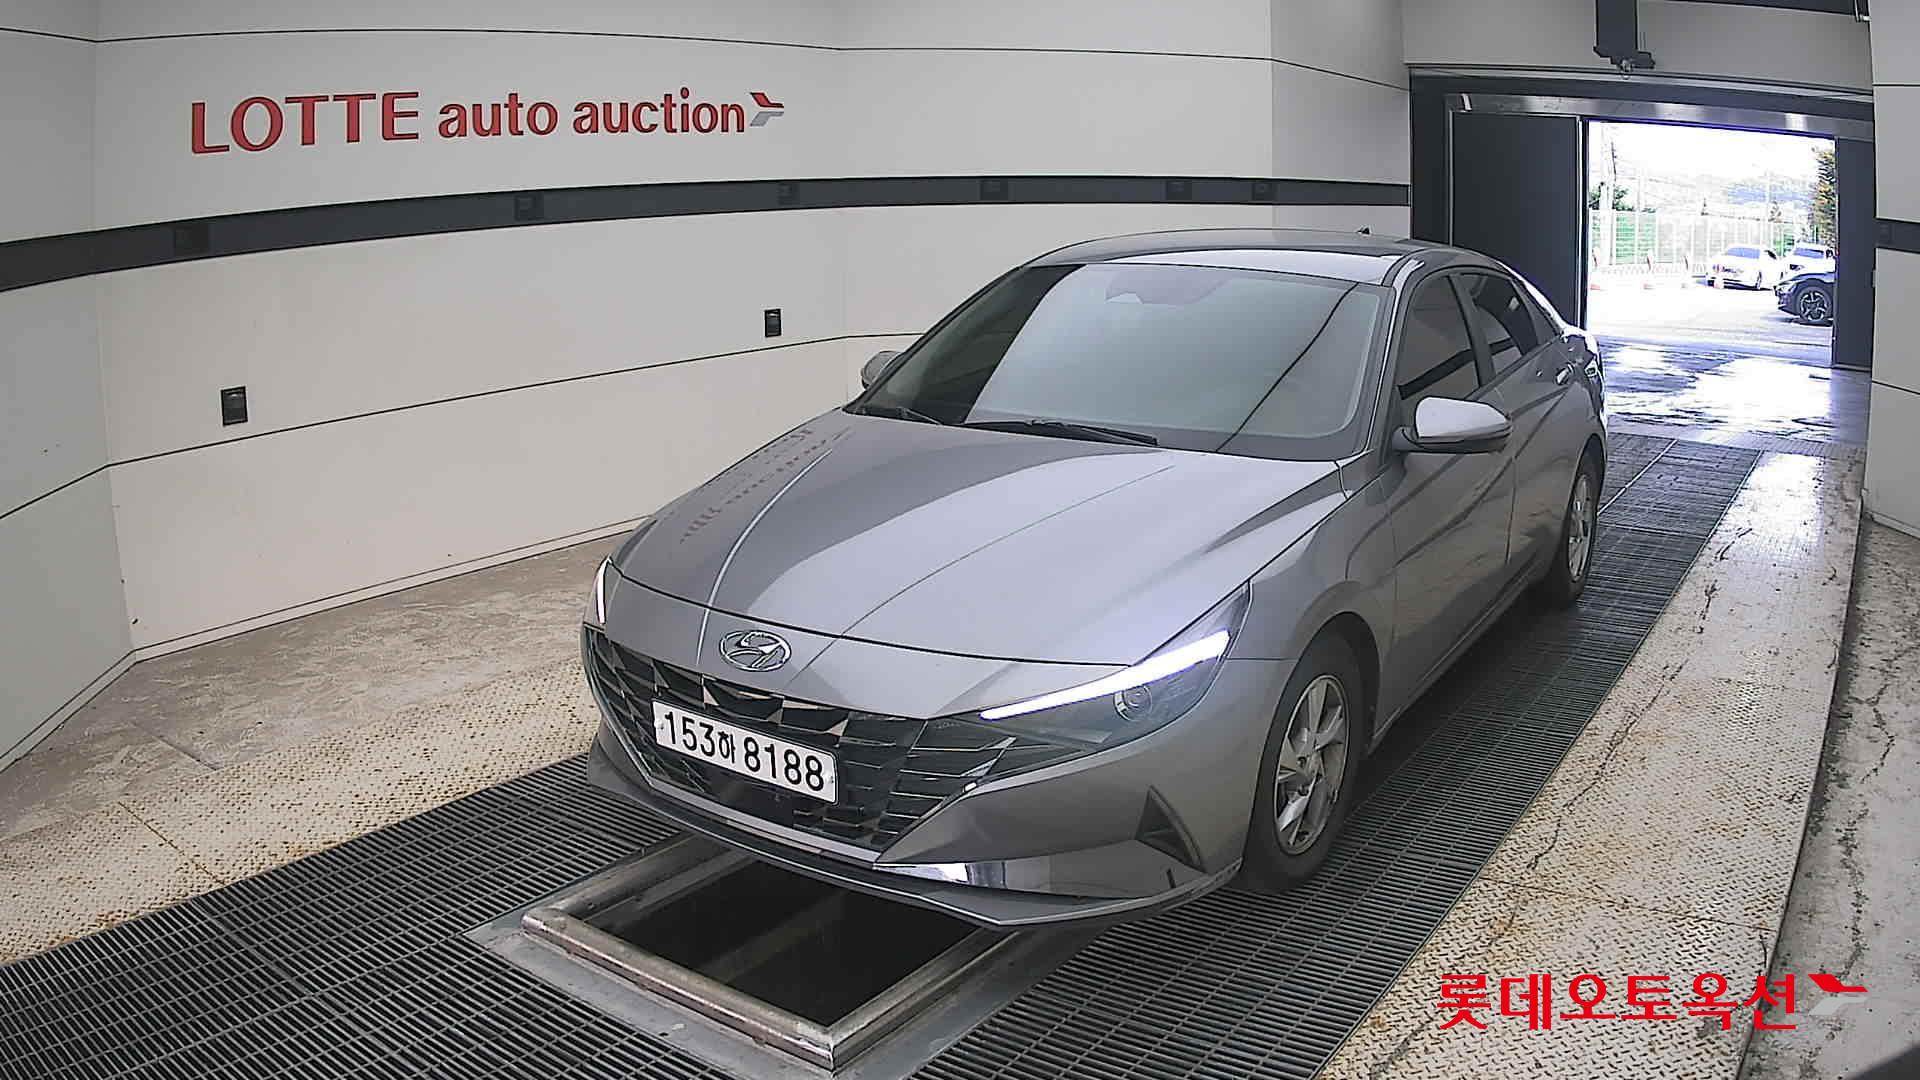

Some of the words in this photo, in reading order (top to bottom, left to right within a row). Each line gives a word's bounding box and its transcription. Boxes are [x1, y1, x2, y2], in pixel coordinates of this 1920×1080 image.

[191, 91, 419, 154] LOTTE
[438, 93, 558, 138] auto
[573, 87, 745, 135] auction
